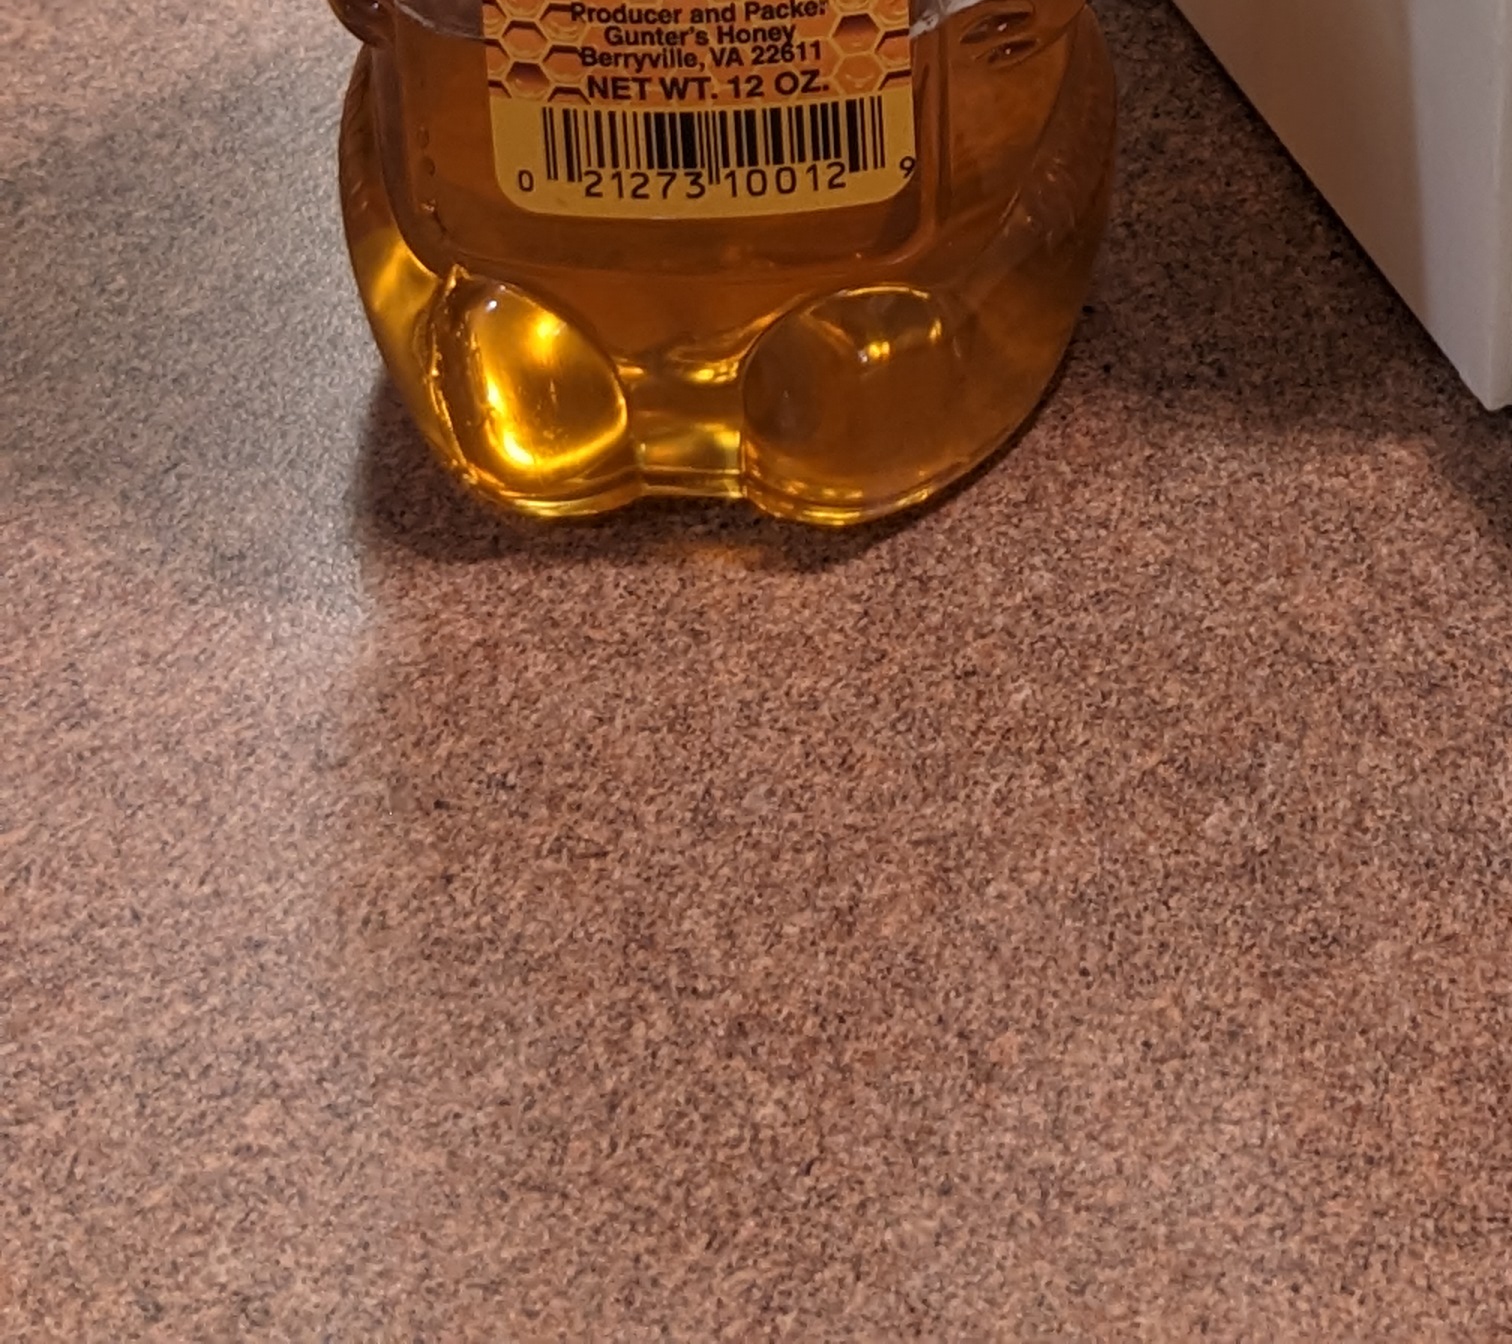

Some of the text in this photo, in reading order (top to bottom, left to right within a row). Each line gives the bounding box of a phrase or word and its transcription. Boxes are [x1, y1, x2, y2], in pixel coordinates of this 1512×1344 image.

[570, 2, 681, 24] Producer
[690, 3, 736, 23] and
[604, 24, 795, 47] Gunter's Honey
[581, 40, 821, 73] Berryville, VA 22611
[587, 69, 829, 101] NET WT. 12 OZ.
[517, 155, 916, 199] 0 21273 10012 9
